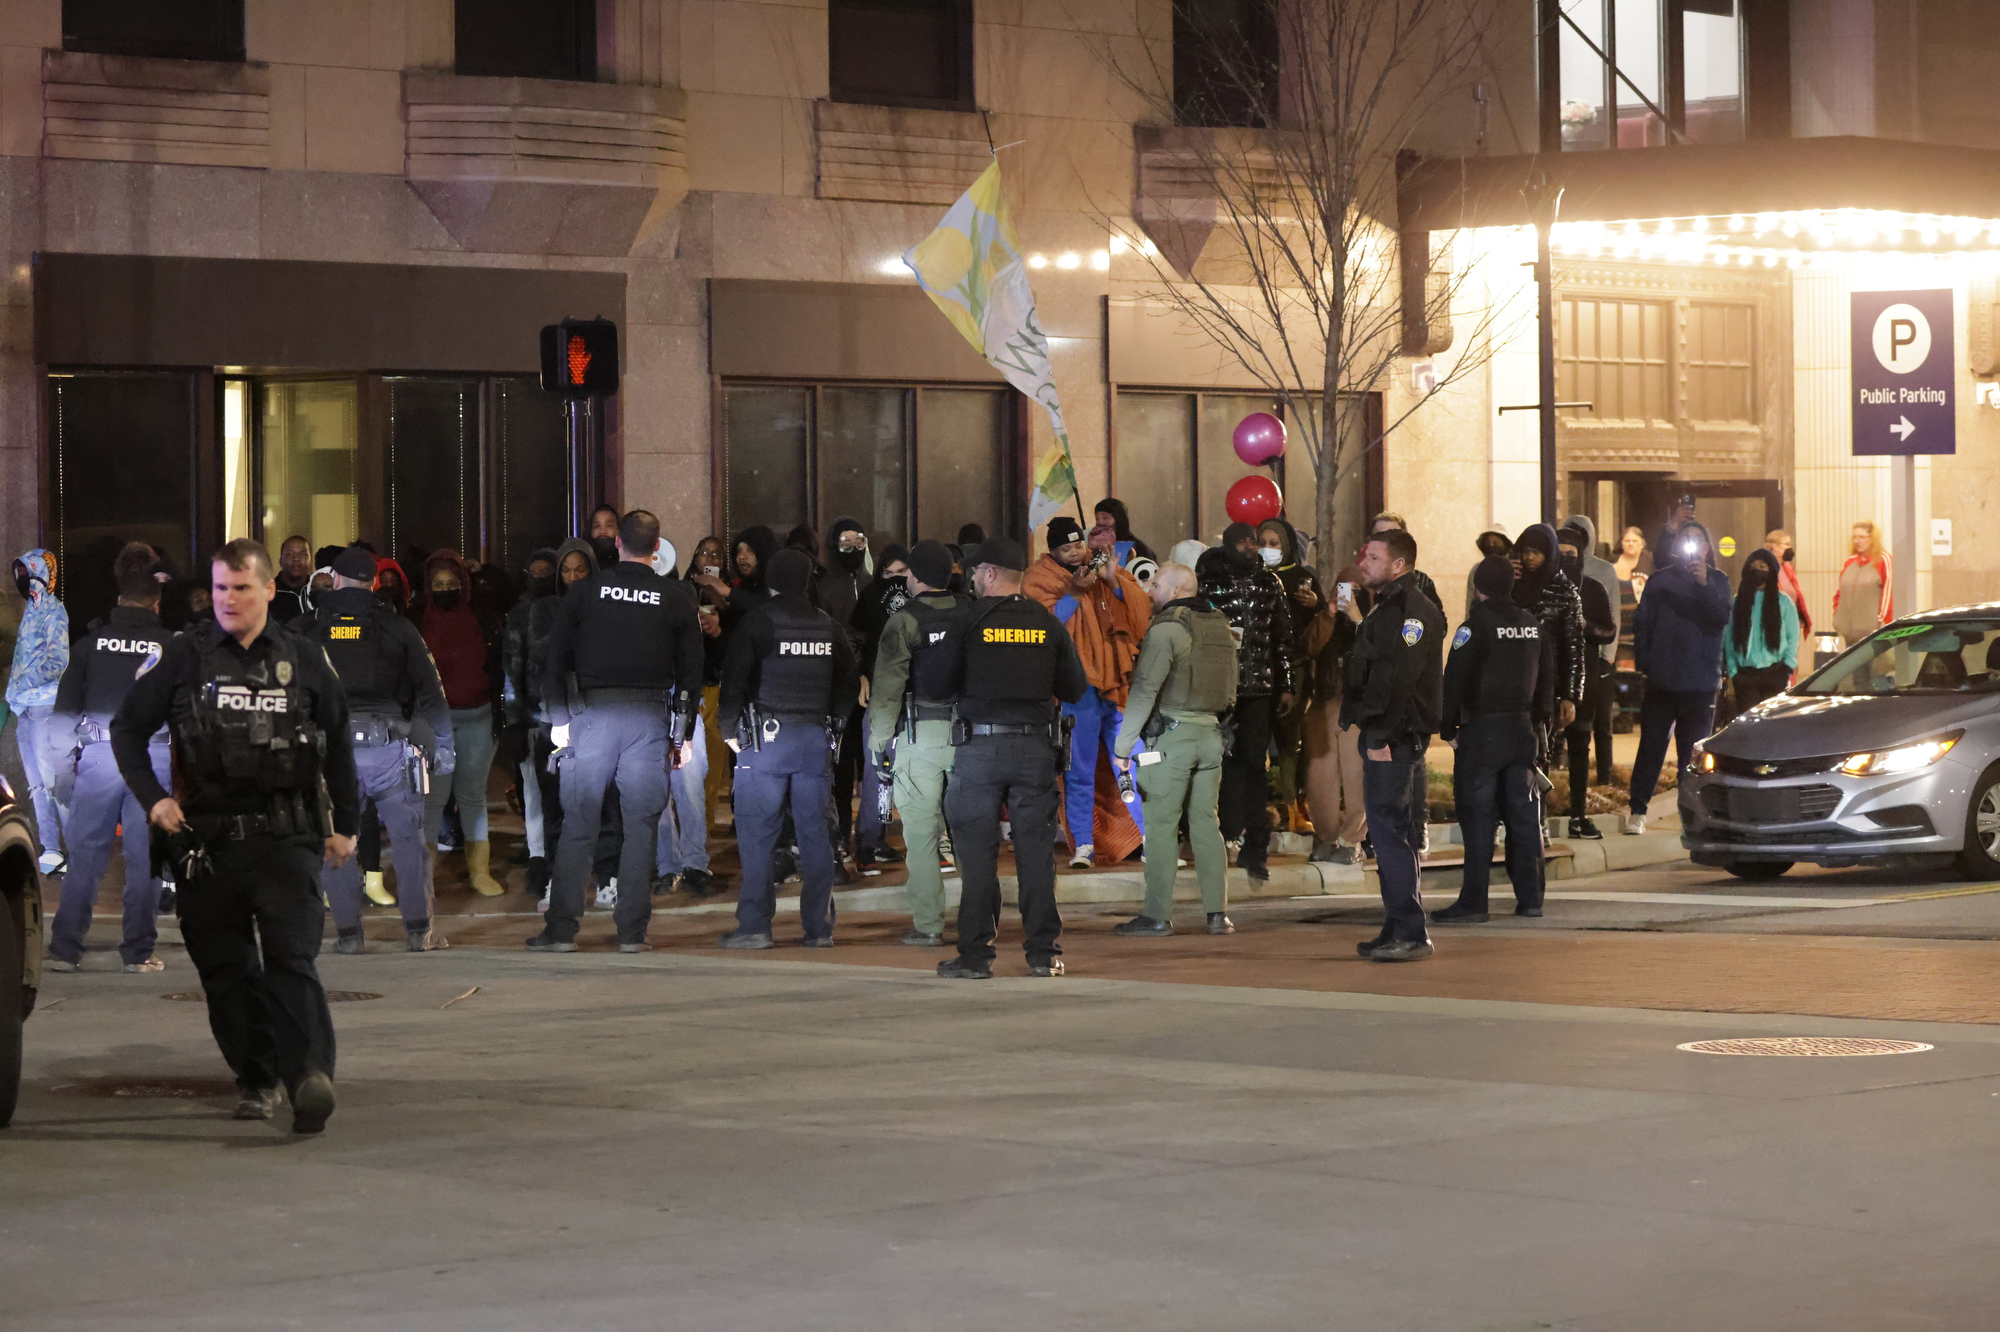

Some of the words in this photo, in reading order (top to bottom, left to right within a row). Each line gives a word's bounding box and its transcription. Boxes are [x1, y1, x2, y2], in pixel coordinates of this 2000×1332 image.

[1890, 318, 1917, 362] P
[1860, 387, 1896, 404] Public
[1899, 387, 1946, 406] Parking
[599, 586, 661, 605] POLICE
[330, 626, 362, 640] SHERIFF
[982, 628, 1047, 644] SHERIFF
[1496, 626, 1539, 639] POLICE
[96, 638, 159, 654] POLICE
[779, 641, 832, 656] POLICE
[217, 694, 288, 713] POLICE
